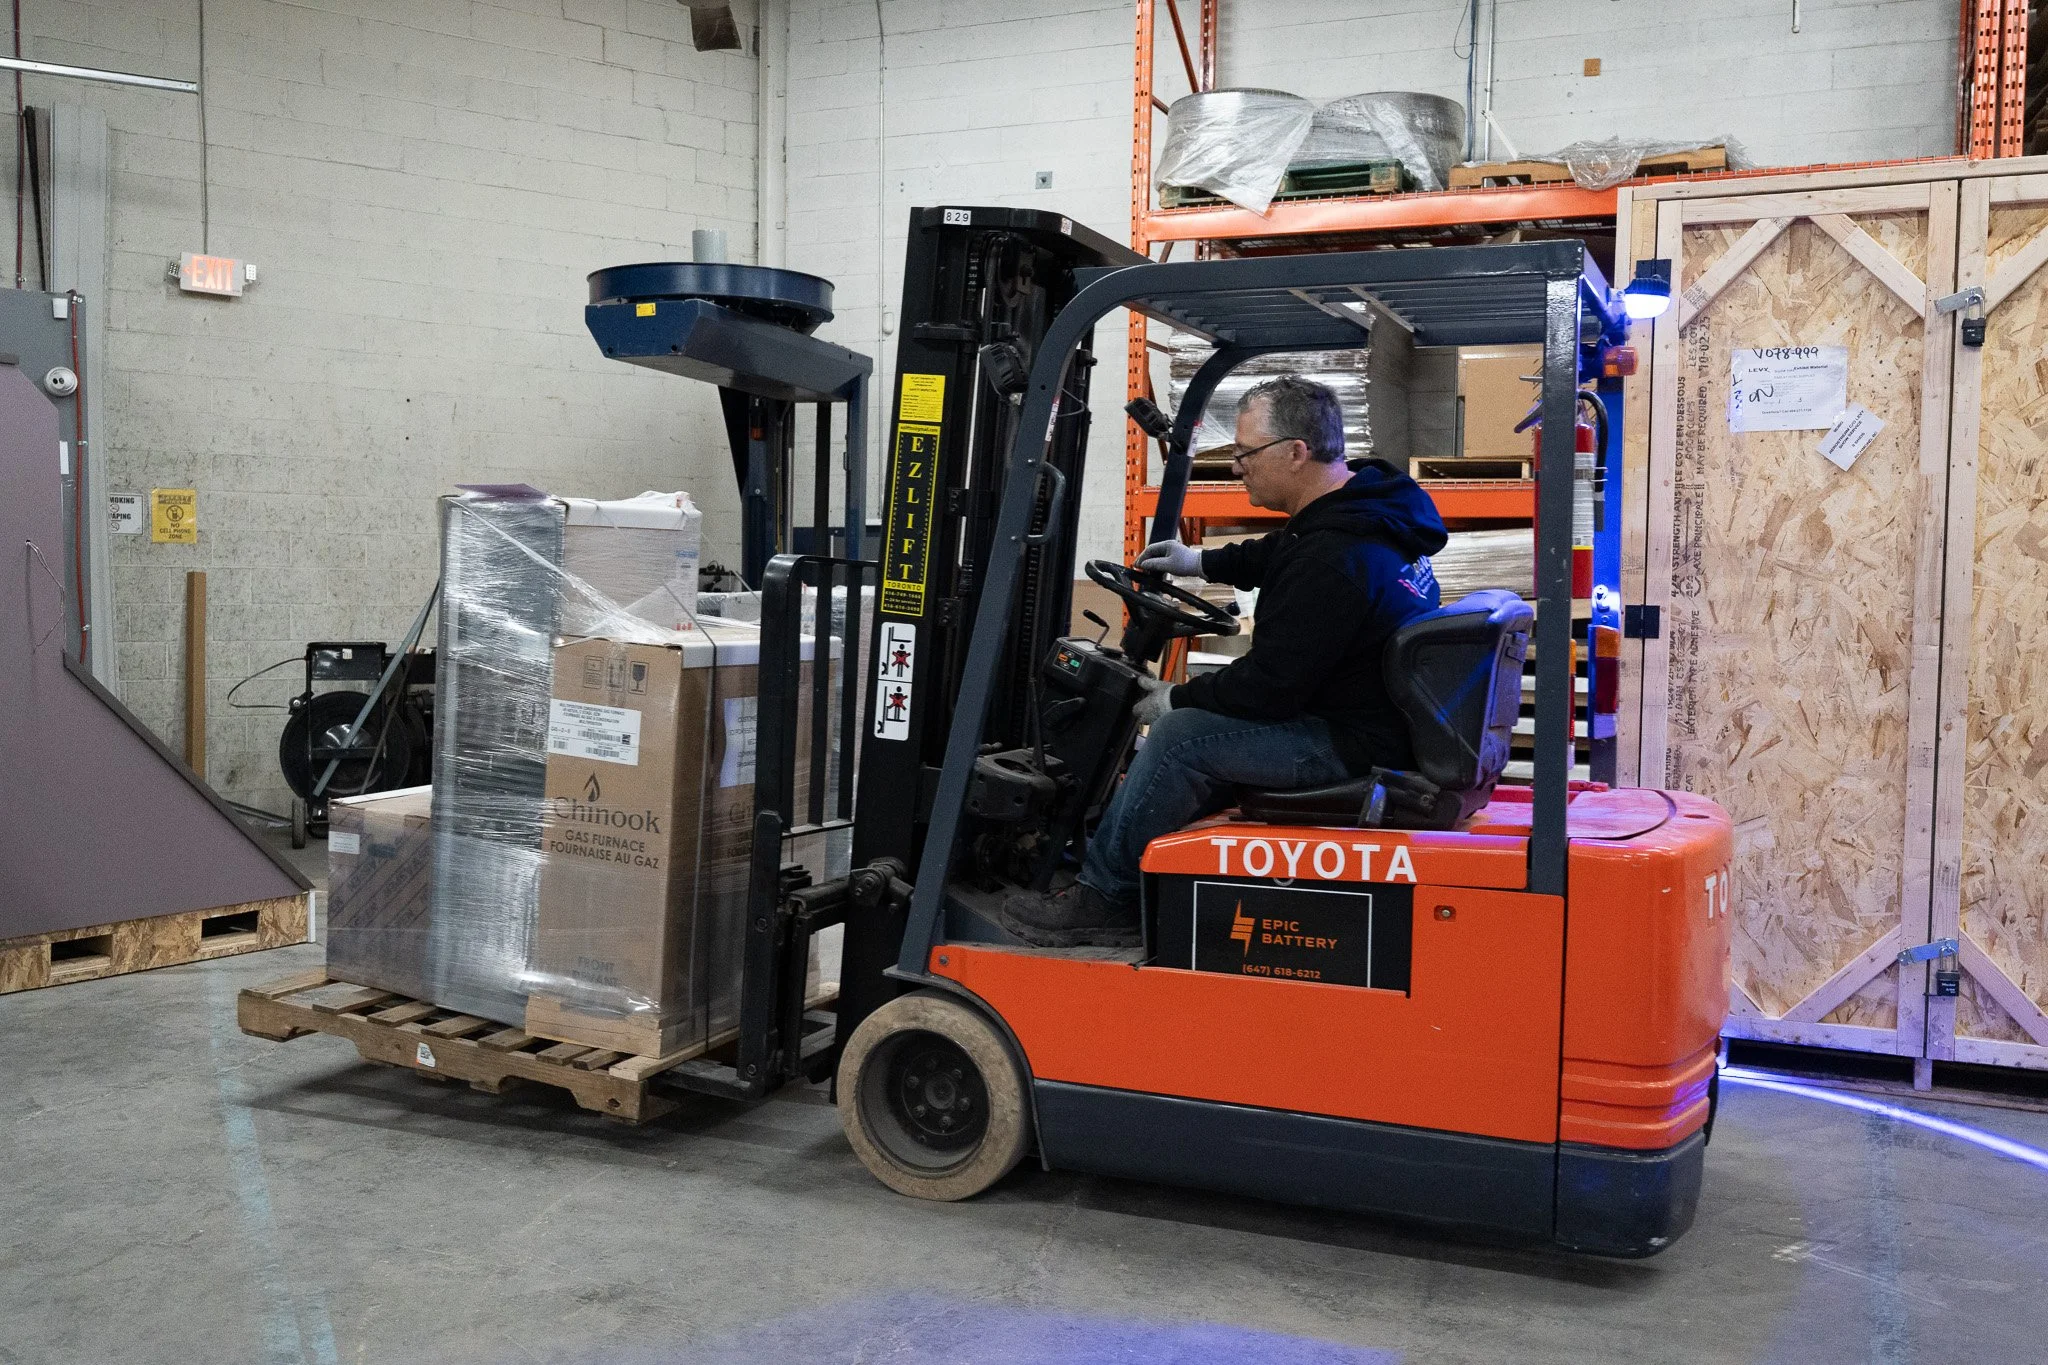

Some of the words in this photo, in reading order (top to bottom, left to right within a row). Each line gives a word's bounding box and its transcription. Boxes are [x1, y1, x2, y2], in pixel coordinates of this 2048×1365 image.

[945, 211, 969, 222] 829
[191, 255, 234, 291] EXIT
[1676, 376, 1686, 422] DESSOUS
[1676, 425, 1684, 438] EN
[1697, 439, 1705, 452] BE
[1696, 454, 1705, 475] MAY
[110, 496, 135, 504] MOKING
[1674, 491, 1682, 512] AXIS
[1693, 491, 1704, 548] PRINCIPALE
[1672, 515, 1681, 569] STRENGTH
[1693, 551, 1702, 570] AXE
[887, 581, 922, 591] TORONTO
[555, 797, 660, 834] Chinook
[565, 829, 589, 843] GAS
[592, 834, 645, 852] FURNACE
[550, 840, 611, 861] FOURNAISE
[614, 852, 631, 865] AU
[634, 855, 659, 869] GAZ
[1210, 838, 1418, 883] TOYOTA
[1262, 918, 1299, 932] EPIC
[1262, 934, 1338, 950] BATTERY
[1242, 964, 1271, 976] (647)
[1273, 966, 1321, 979] 618-6212
